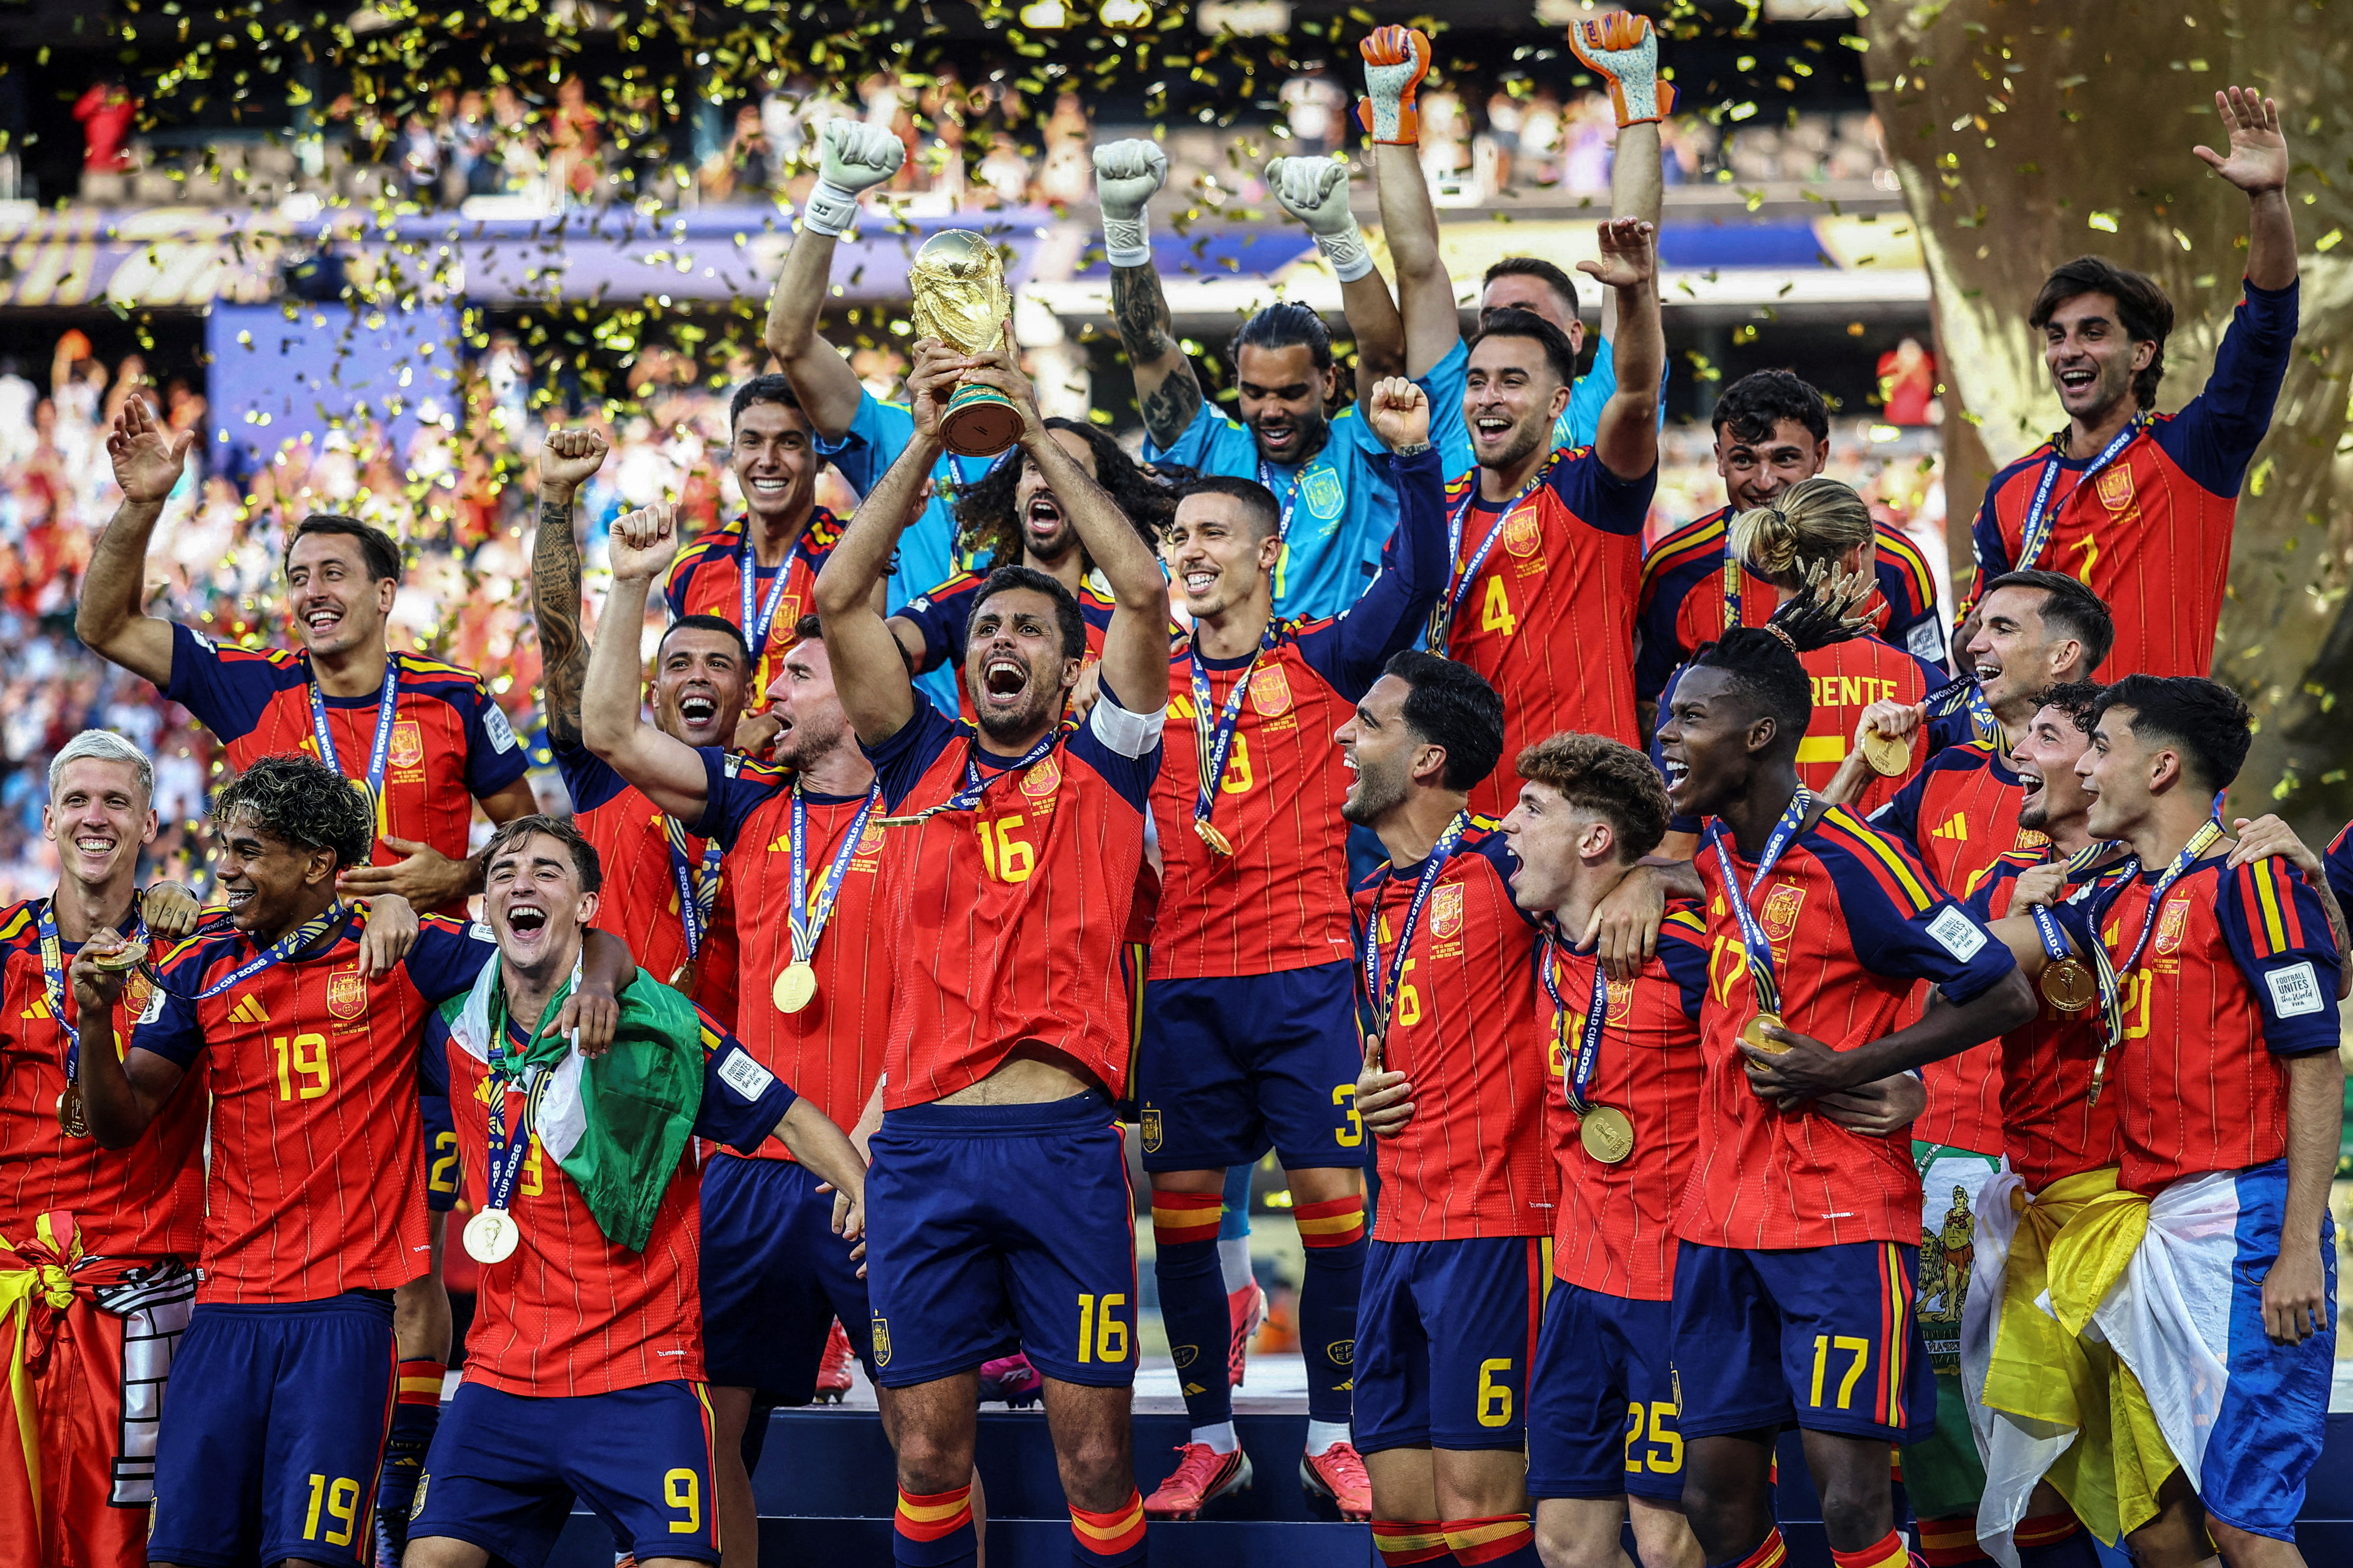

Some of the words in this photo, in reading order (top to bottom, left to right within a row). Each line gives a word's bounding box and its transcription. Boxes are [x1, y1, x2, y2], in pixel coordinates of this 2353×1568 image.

[2090, 456, 2107, 472] CUP
[2104, 432, 2131, 459] 2026
[2042, 460, 2058, 488] 2026
[2036, 486, 2049, 503] CUP
[2030, 503, 2043, 528] WORLD
[1454, 583, 1466, 602] FIFA
[1462, 554, 1483, 584] WORLD
[1481, 535, 1494, 554] CUP
[2069, 532, 2099, 587] 7
[757, 615, 769, 636] FIFA
[764, 586, 781, 616] WORLD
[1481, 574, 1516, 636] 4
[385, 674, 396, 703] 2026
[1809, 676, 1898, 707] RENTE
[1930, 684, 1959, 702] WORLD
[1958, 676, 1974, 686] CUP
[382, 704, 392, 722] CUP
[316, 716, 324, 736] FIFA
[320, 736, 335, 767] WORLD
[376, 723, 389, 754] WORLD
[1031, 742, 1050, 756] FIFA
[1214, 729, 1229, 762] 2026
[372, 754, 383, 773] FIFA
[969, 761, 979, 783] 2026
[1221, 731, 1254, 794] 3
[793, 826, 802, 858] WORLD
[832, 860, 845, 878] FIFA
[840, 831, 858, 862] WORLD
[855, 812, 867, 831] CUP
[976, 815, 1035, 882] 16
[793, 858, 802, 876] CUP
[1424, 858, 1439, 880] FIFA
[1724, 865, 1734, 885] CUP
[1752, 866, 1765, 887] CUP
[1763, 833, 1784, 866] 2026
[678, 866, 692, 899] 2026
[1412, 880, 1430, 916] WORLD
[684, 900, 694, 918] CUP
[1730, 885, 1748, 925] WORLD
[2144, 903, 2154, 927] FIFA
[687, 919, 697, 954] WORLD
[1369, 912, 1377, 931] CUP
[1405, 915, 1415, 937] CUP
[1742, 925, 1751, 946] FIFA
[1746, 909, 1764, 946] 2026
[1936, 917, 1957, 934] FOOTBALL
[1943, 921, 1965, 941] UNITES
[2039, 913, 2057, 947] WORLD
[1366, 932, 1377, 974] WORLD
[1394, 936, 1408, 971] 2026
[1963, 939, 1973, 948] FIFA
[2128, 927, 2149, 963] WORLD
[220, 974, 237, 987] CUP
[237, 958, 268, 978] 2026
[1366, 975, 1376, 994] FIFA
[1710, 934, 1747, 1009] 17
[2276, 972, 2306, 985] FOOTBALL
[2278, 979, 2309, 994] UNITES
[1398, 957, 1421, 1027] 6
[1547, 981, 1559, 1004] FIFA
[2292, 989, 2313, 1001] World
[1590, 991, 1603, 1026] WORLD
[1586, 1027, 1597, 1047] CUP
[273, 1033, 331, 1101] 19
[727, 1056, 745, 1077] FOOTBALL
[732, 1061, 752, 1081] UNITES
[753, 1077, 762, 1085] FIFA
[1577, 1047, 1592, 1084] 2026
[1332, 1083, 1362, 1147] 3
[498, 1178, 510, 1198] CUP
[505, 1144, 522, 1178] 2026
[1078, 1293, 1127, 1364] 16
[1335, 1344, 1353, 1352] RF
[1336, 1351, 1353, 1360] EF
[1810, 1335, 1869, 1410] 17
[1477, 1358, 1512, 1427] 6
[1625, 1401, 1684, 1474] 25
[303, 1473, 360, 1546] 19
[664, 1468, 700, 1534] 9
